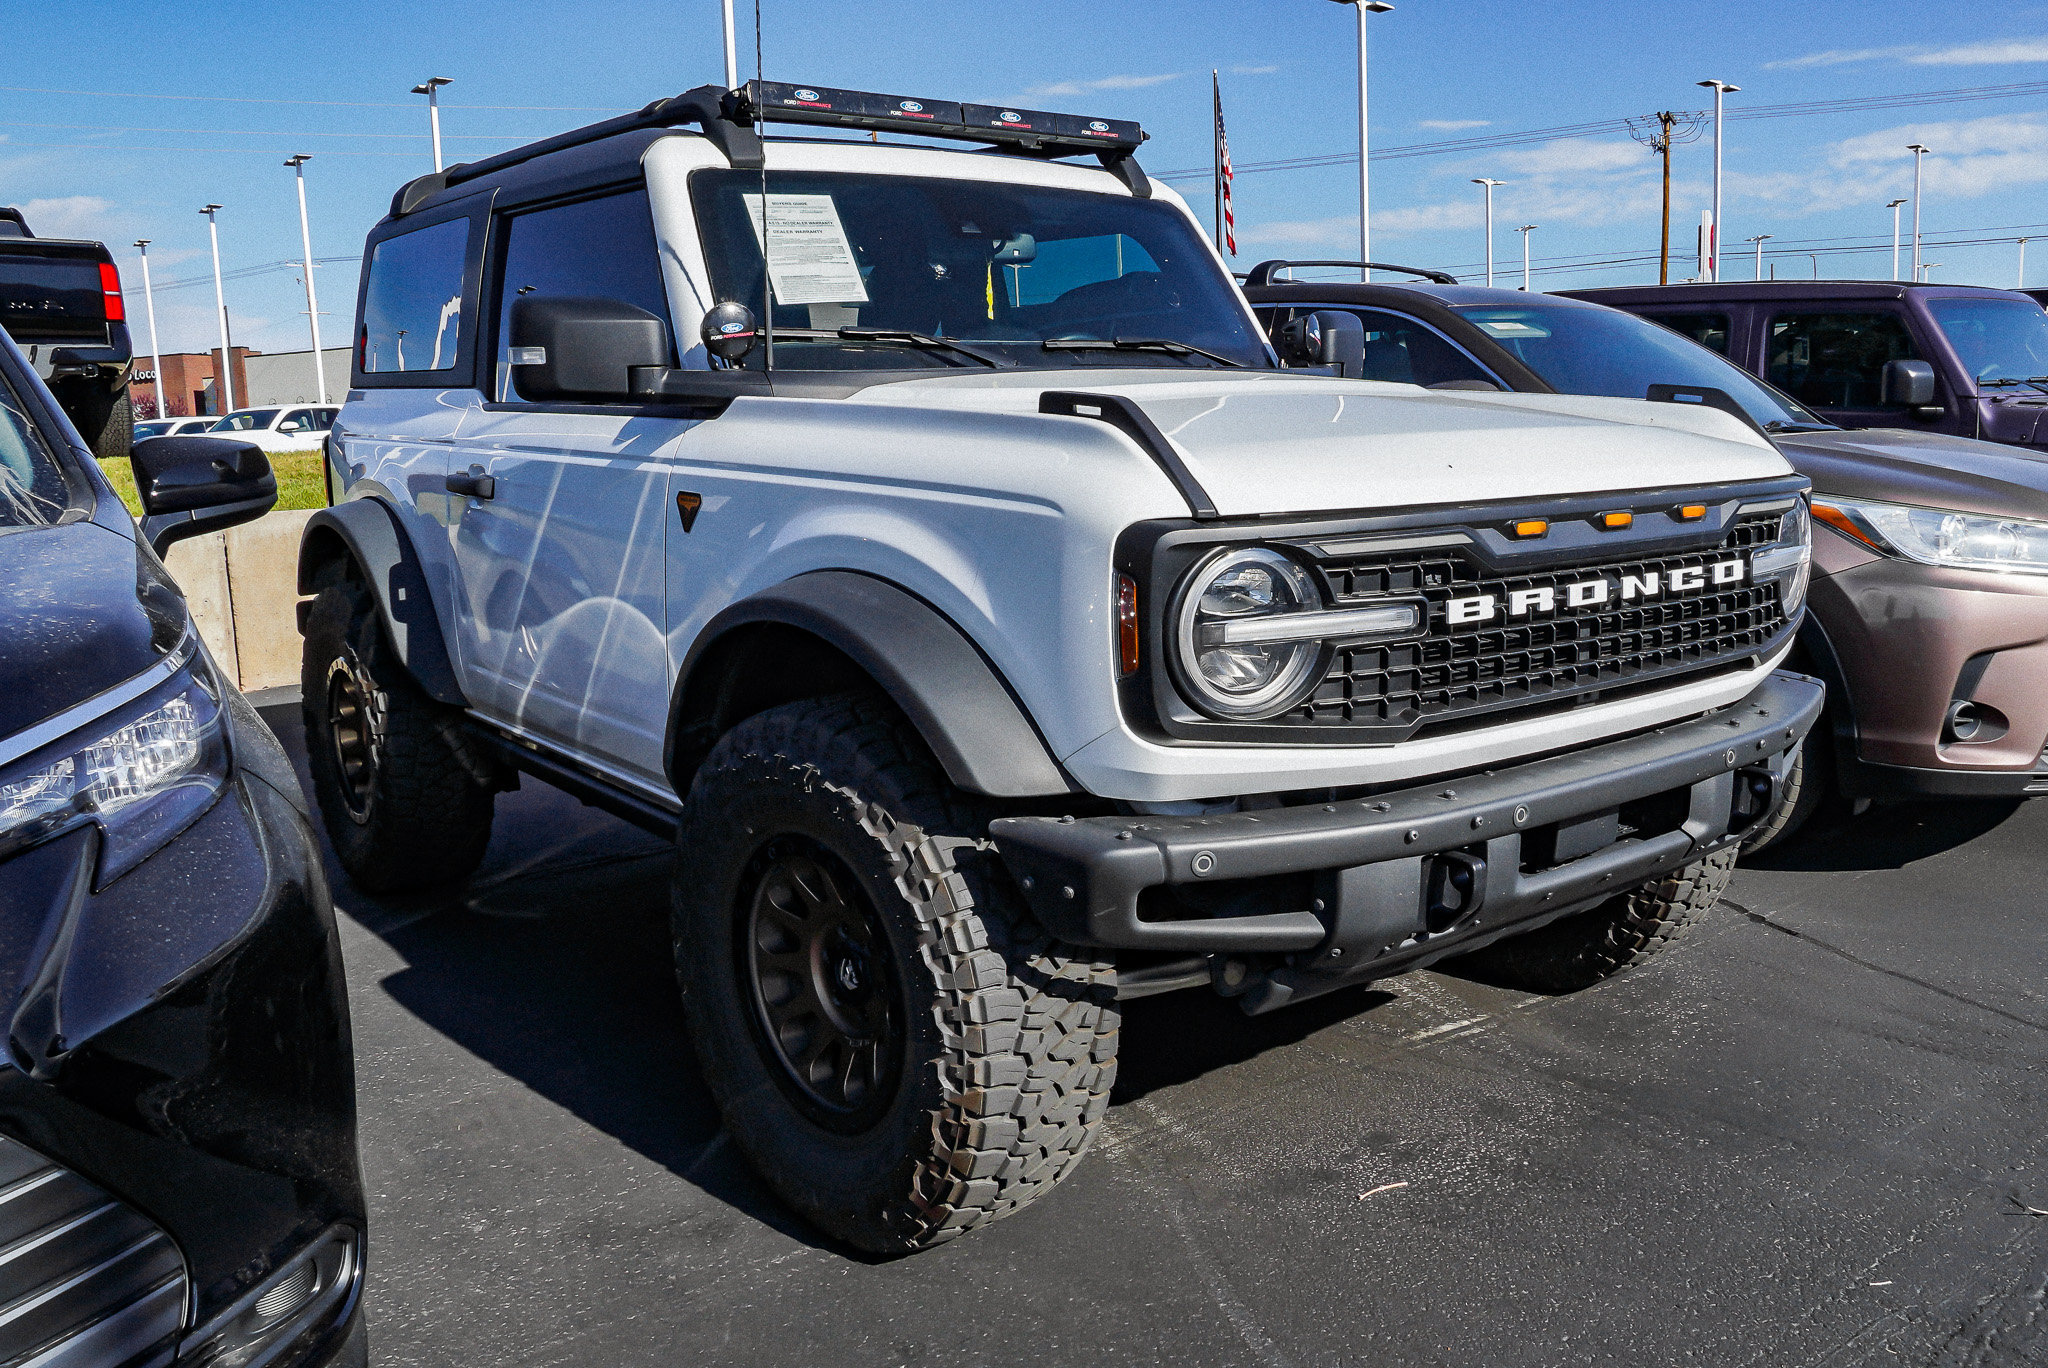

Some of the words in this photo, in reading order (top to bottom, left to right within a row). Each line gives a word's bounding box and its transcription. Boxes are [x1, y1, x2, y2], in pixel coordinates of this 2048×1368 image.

[796, 91, 818, 100] Ford
[797, 100, 831, 108] PERFORMANCE
[901, 102, 922, 111] Ford
[902, 111, 934, 119] PERFORMANCE
[1001, 113, 1020, 121] Ford
[1003, 121, 1031, 129] PERFORMANCE
[1090, 122, 1108, 131] Ford
[722, 324, 742, 332] Ford
[1446, 559, 1744, 624] BRONCO
